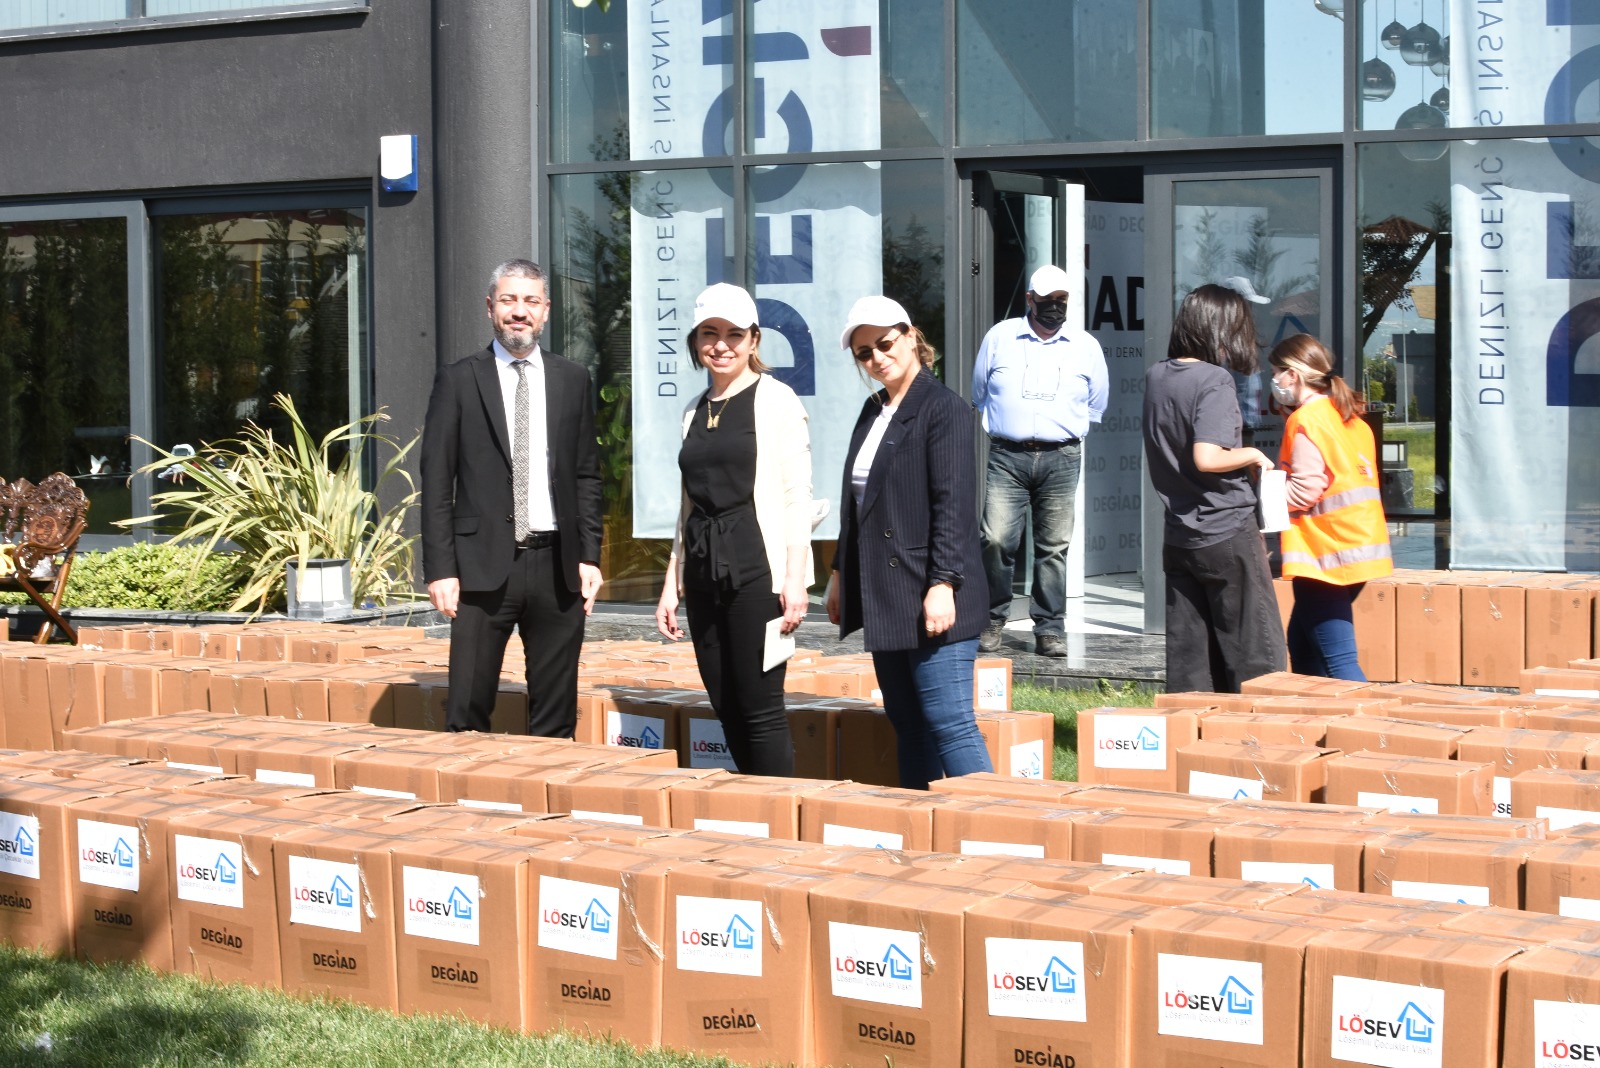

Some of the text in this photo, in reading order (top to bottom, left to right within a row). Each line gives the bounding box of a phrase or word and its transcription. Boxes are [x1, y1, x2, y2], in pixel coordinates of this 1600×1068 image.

[1085, 206, 1106, 232] İAD
[1085, 452, 1106, 473] İAD
[1085, 527, 1106, 552] İAD
[693, 740, 729, 754] LÖSEV
[82, 847, 117, 866] LÖSEV
[180, 864, 218, 882] LÖSEV
[294, 886, 334, 905] LÖSEV
[94, 906, 133, 927] DEGİAD
[409, 897, 452, 917] LÖSEV
[543, 908, 588, 929] LÖSEV
[201, 927, 243, 949] DEGİAD
[682, 928, 730, 948] LÖSEV
[313, 949, 357, 970] DEGİAD
[835, 956, 887, 977] LÖSEV
[431, 962, 479, 984] DEGİAD
[993, 972, 1048, 992] LÖSEV
[561, 979, 612, 1002] DEGİAD
[1165, 989, 1224, 1012] LÖSEV
[703, 1008, 757, 1030] DEGİAD
[1339, 1014, 1402, 1039] LÖSEV
[858, 1021, 916, 1046] DEGİAD
[1014, 1045, 1076, 1068] DEGİAD
[1542, 1039, 1600, 1062] LÖSE
